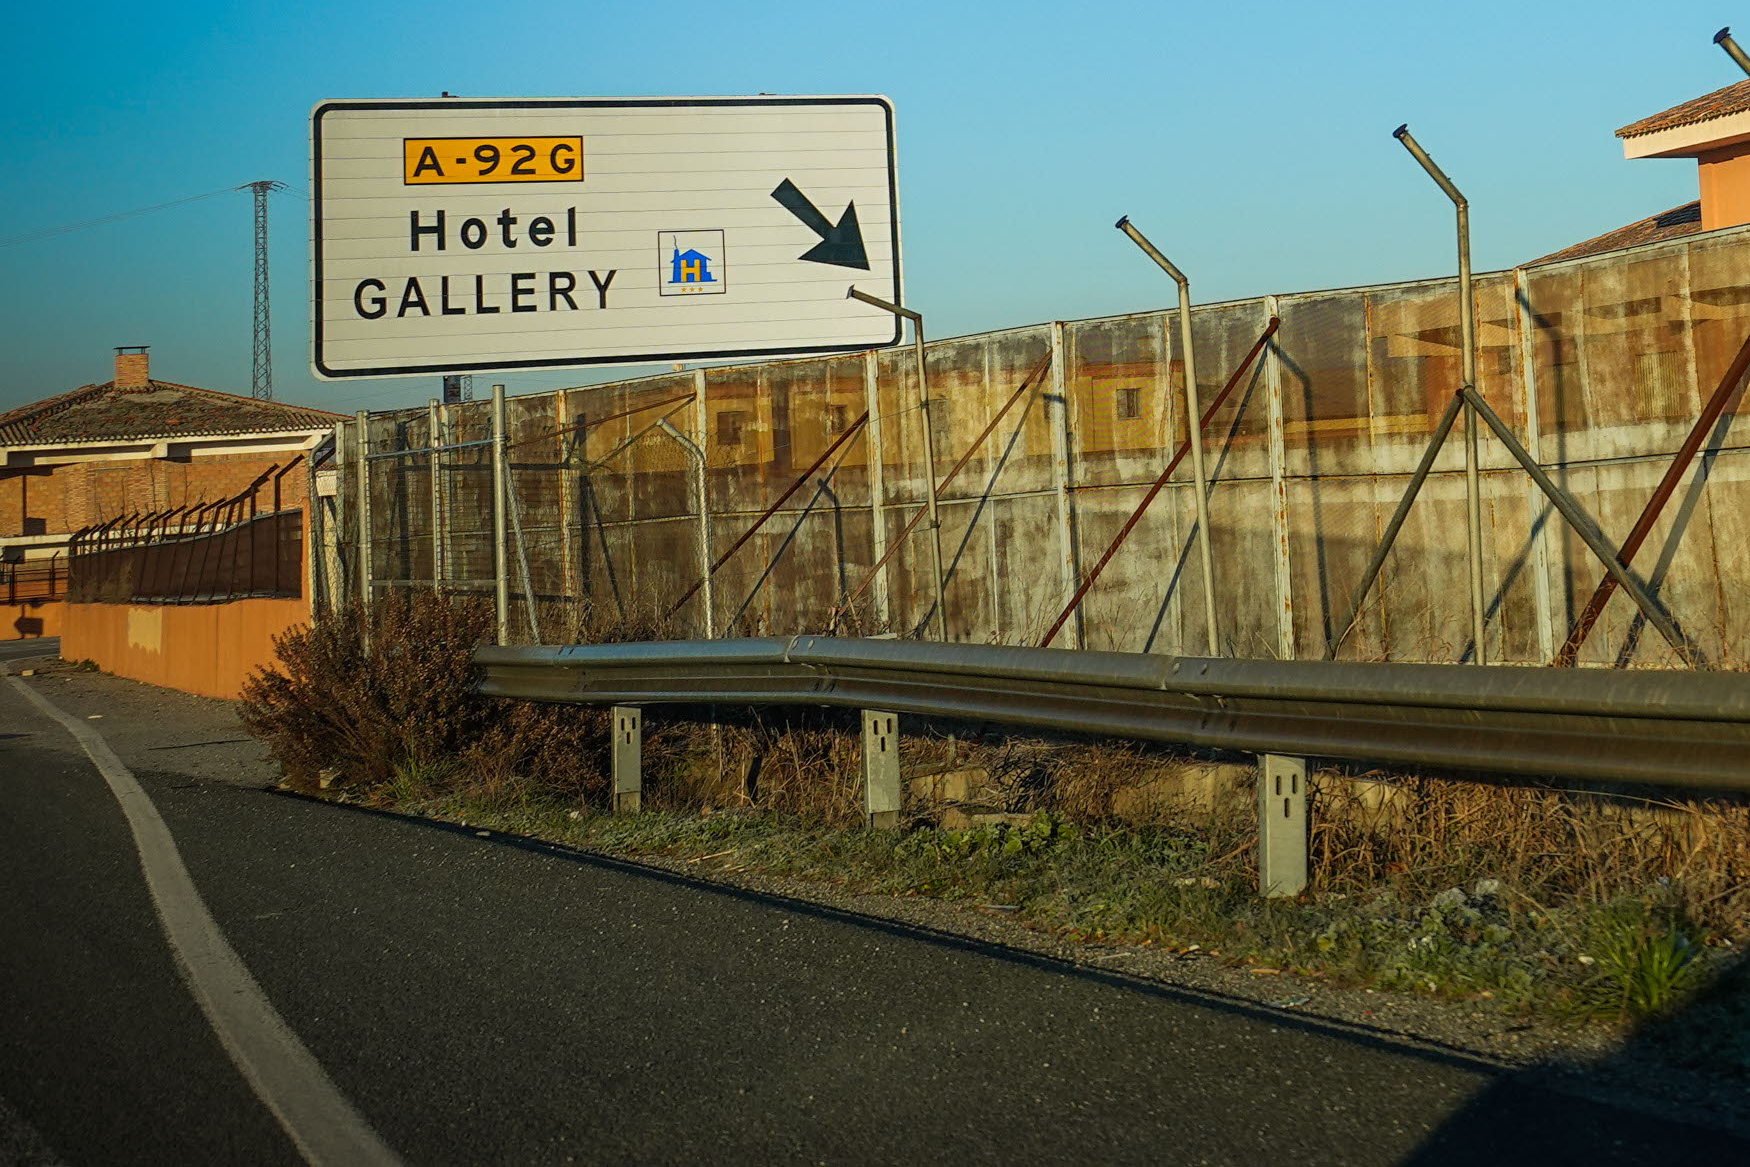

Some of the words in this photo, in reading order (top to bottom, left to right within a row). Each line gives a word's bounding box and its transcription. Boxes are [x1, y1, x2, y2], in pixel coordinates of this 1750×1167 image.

[413, 143, 576, 177] A-92G
[410, 207, 577, 251] Hotel
[680, 259, 702, 283] H
[354, 270, 617, 320] GALLERY
